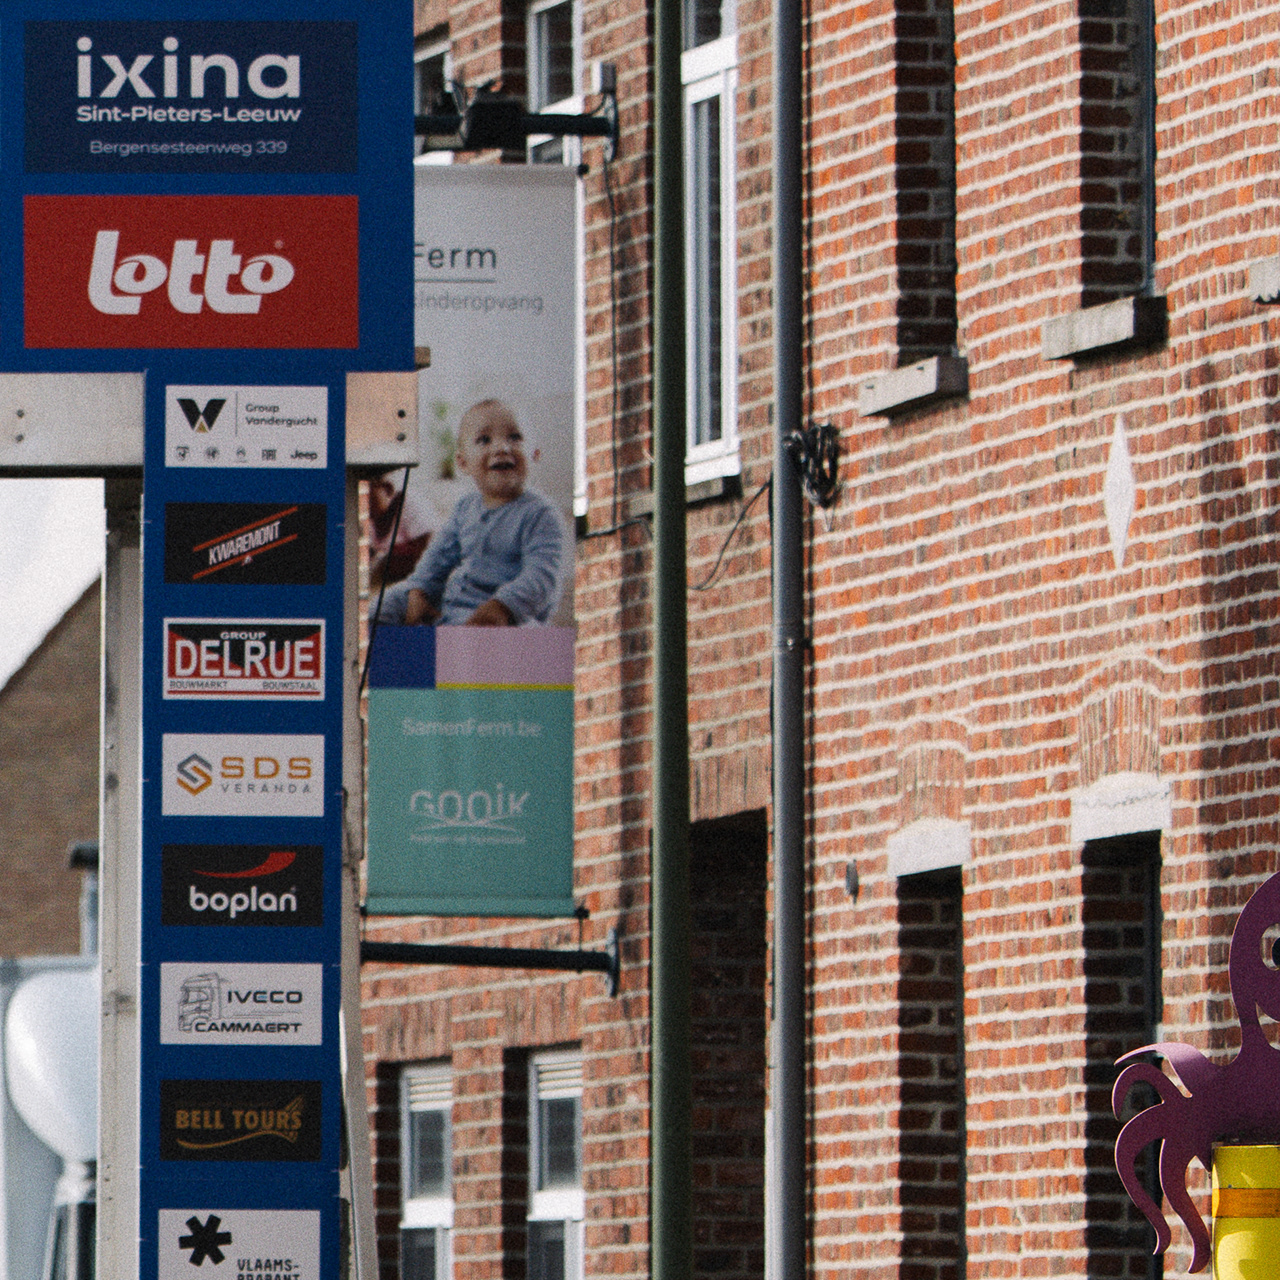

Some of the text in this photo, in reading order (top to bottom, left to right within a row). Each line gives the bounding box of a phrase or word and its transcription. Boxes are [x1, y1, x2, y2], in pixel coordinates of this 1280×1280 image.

[77, 36, 301, 99] ixina
[77, 104, 302, 123] Sint-Pieters-Leeuw
[90, 139, 288, 157] Bergensesteenweg 339
[88, 230, 296, 314] lotto
[245, 403, 280, 414] Group
[245, 416, 318, 428] Vandergucht
[291, 450, 318, 462] Jeep
[209, 521, 281, 566] KWAREMONT
[220, 631, 267, 641] GROUP
[175, 639, 315, 679] DELRUE
[169, 680, 228, 690] BOUWMARKT
[220, 757, 312, 779] SDS
[221, 784, 312, 794] VERANDA
[189, 885, 297, 918] boplan
[227, 990, 303, 1004] IVECO
[195, 1022, 303, 1034] CAMMAERT
[176, 1109, 302, 1130] BELL TOURS
[237, 1258, 300, 1272] VLAAMS-
